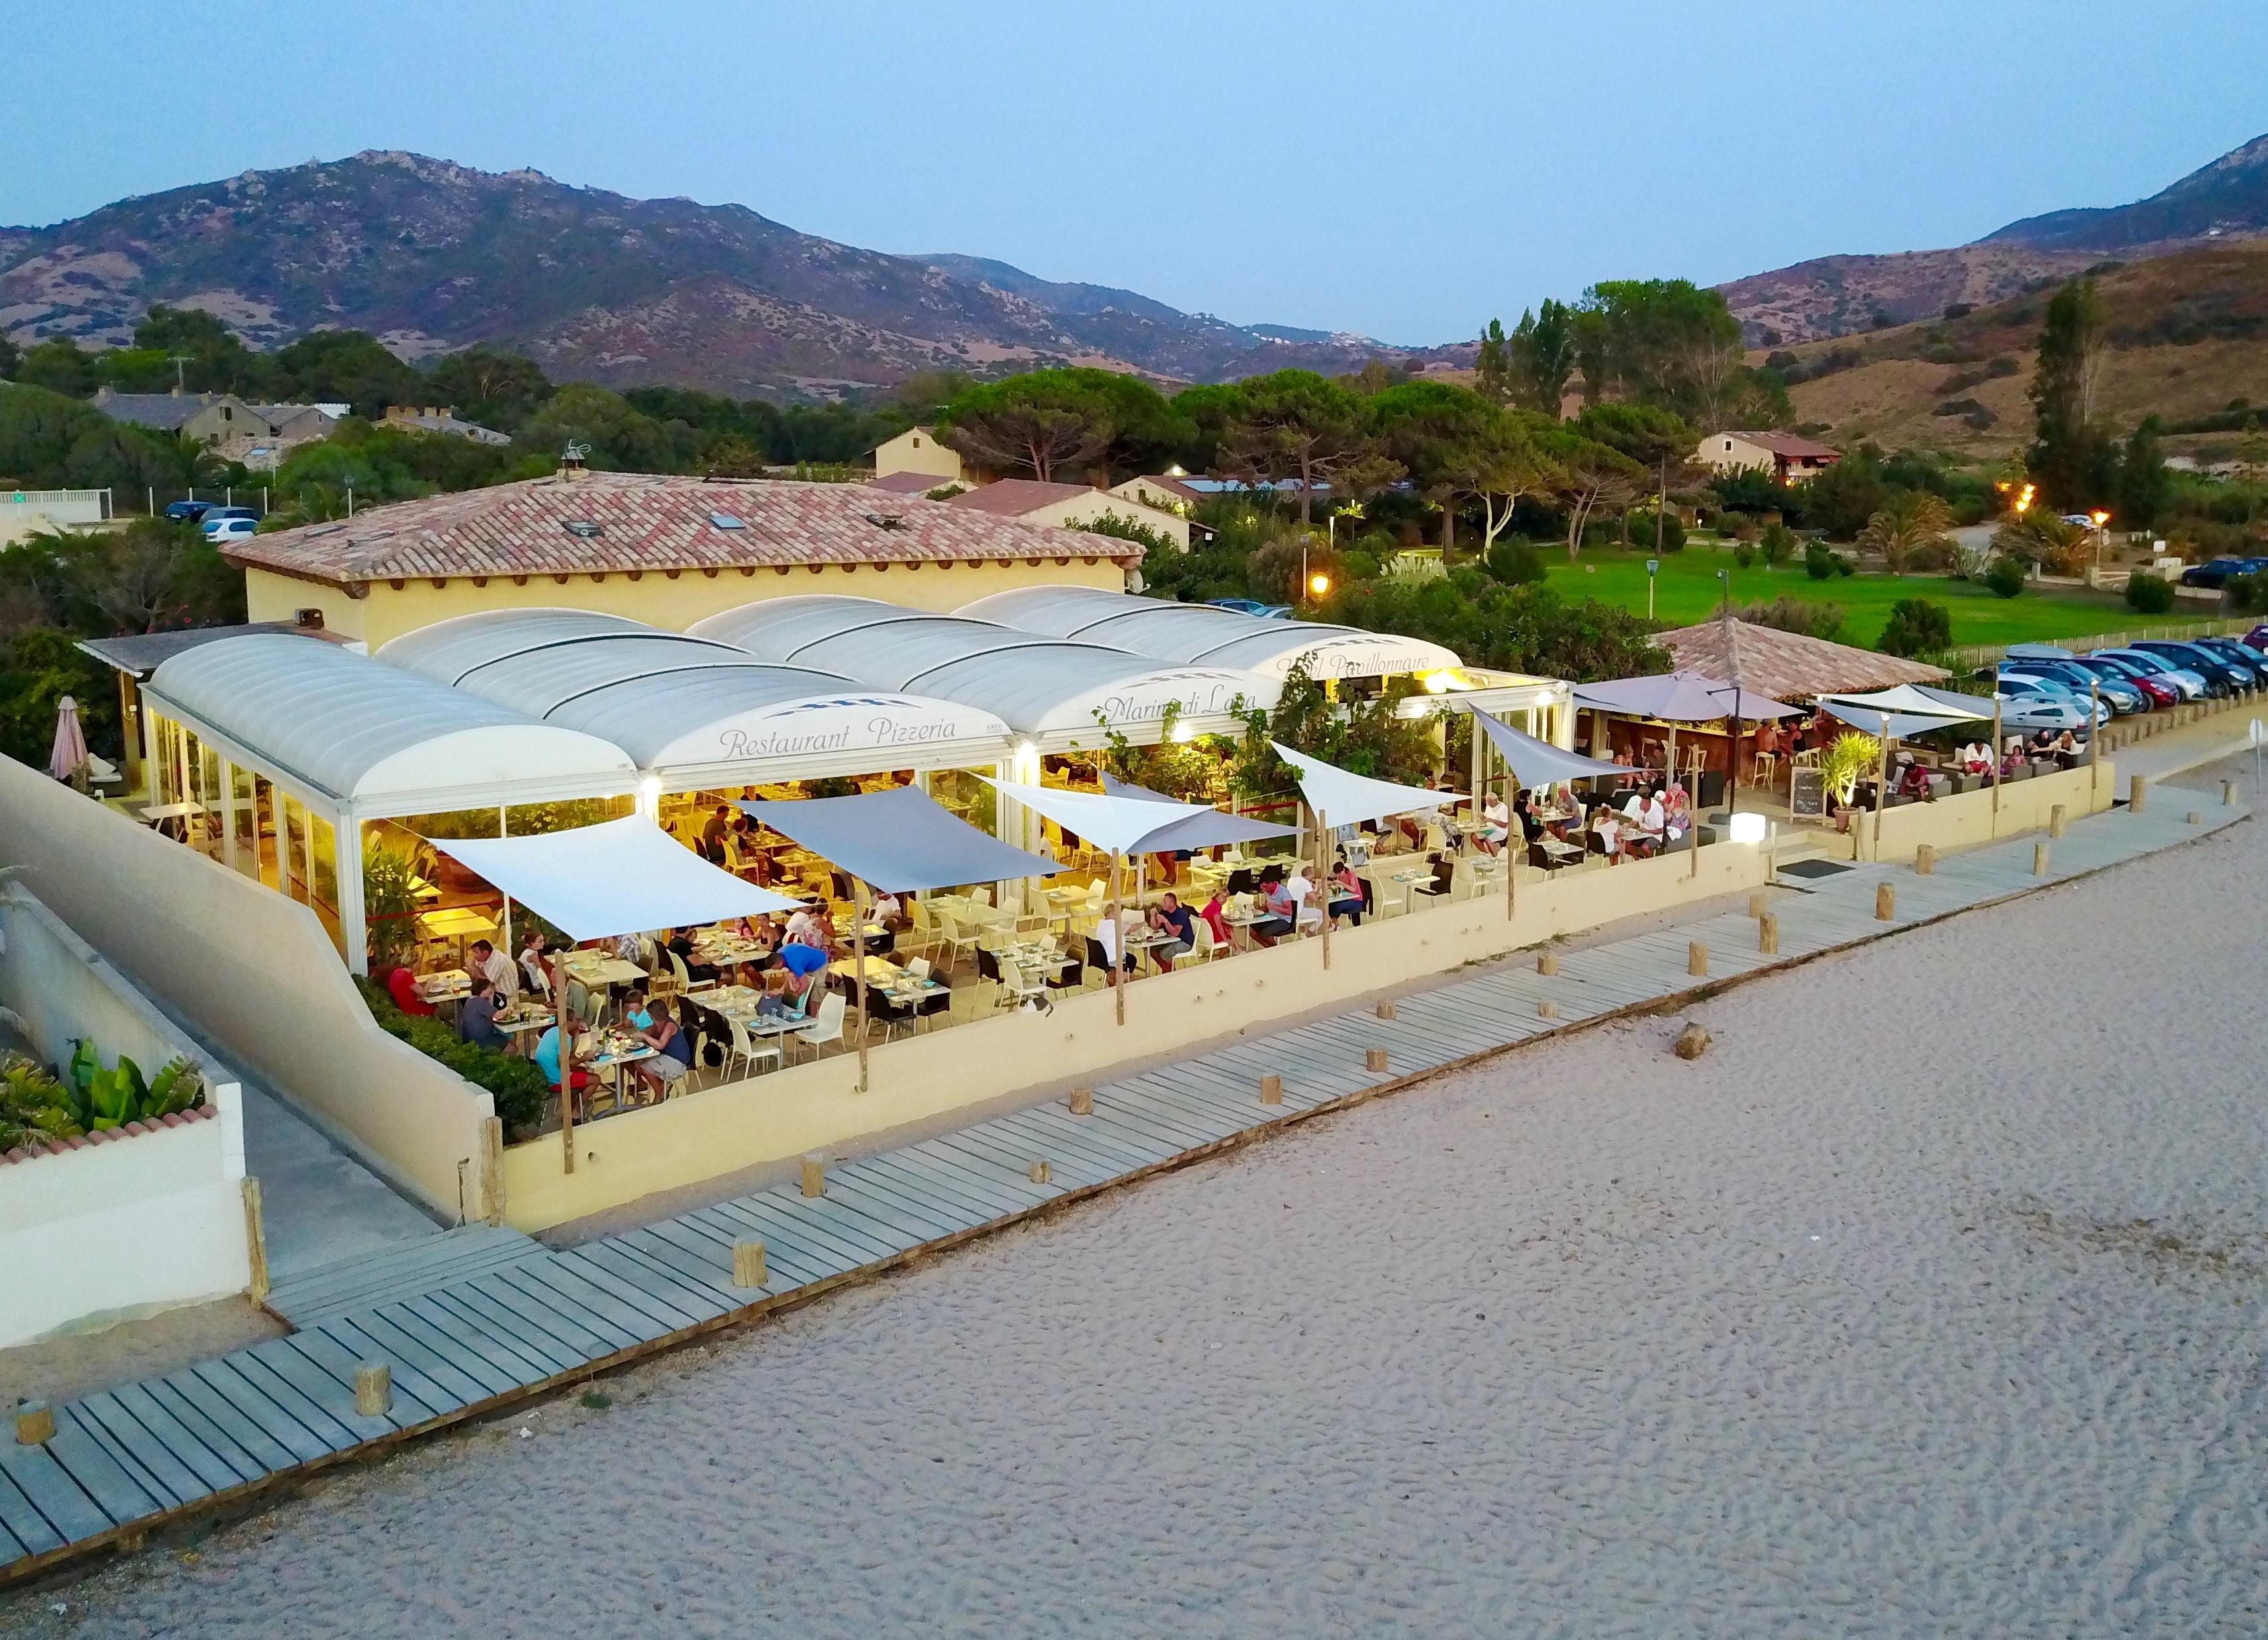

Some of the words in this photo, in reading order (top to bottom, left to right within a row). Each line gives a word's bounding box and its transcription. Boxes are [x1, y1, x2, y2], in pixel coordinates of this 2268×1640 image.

[1104, 696, 1180, 723] Marin
[1183, 692, 1200, 715] di
[720, 725, 850, 759] Restaurant
[867, 717, 956, 743] Pizzeria
